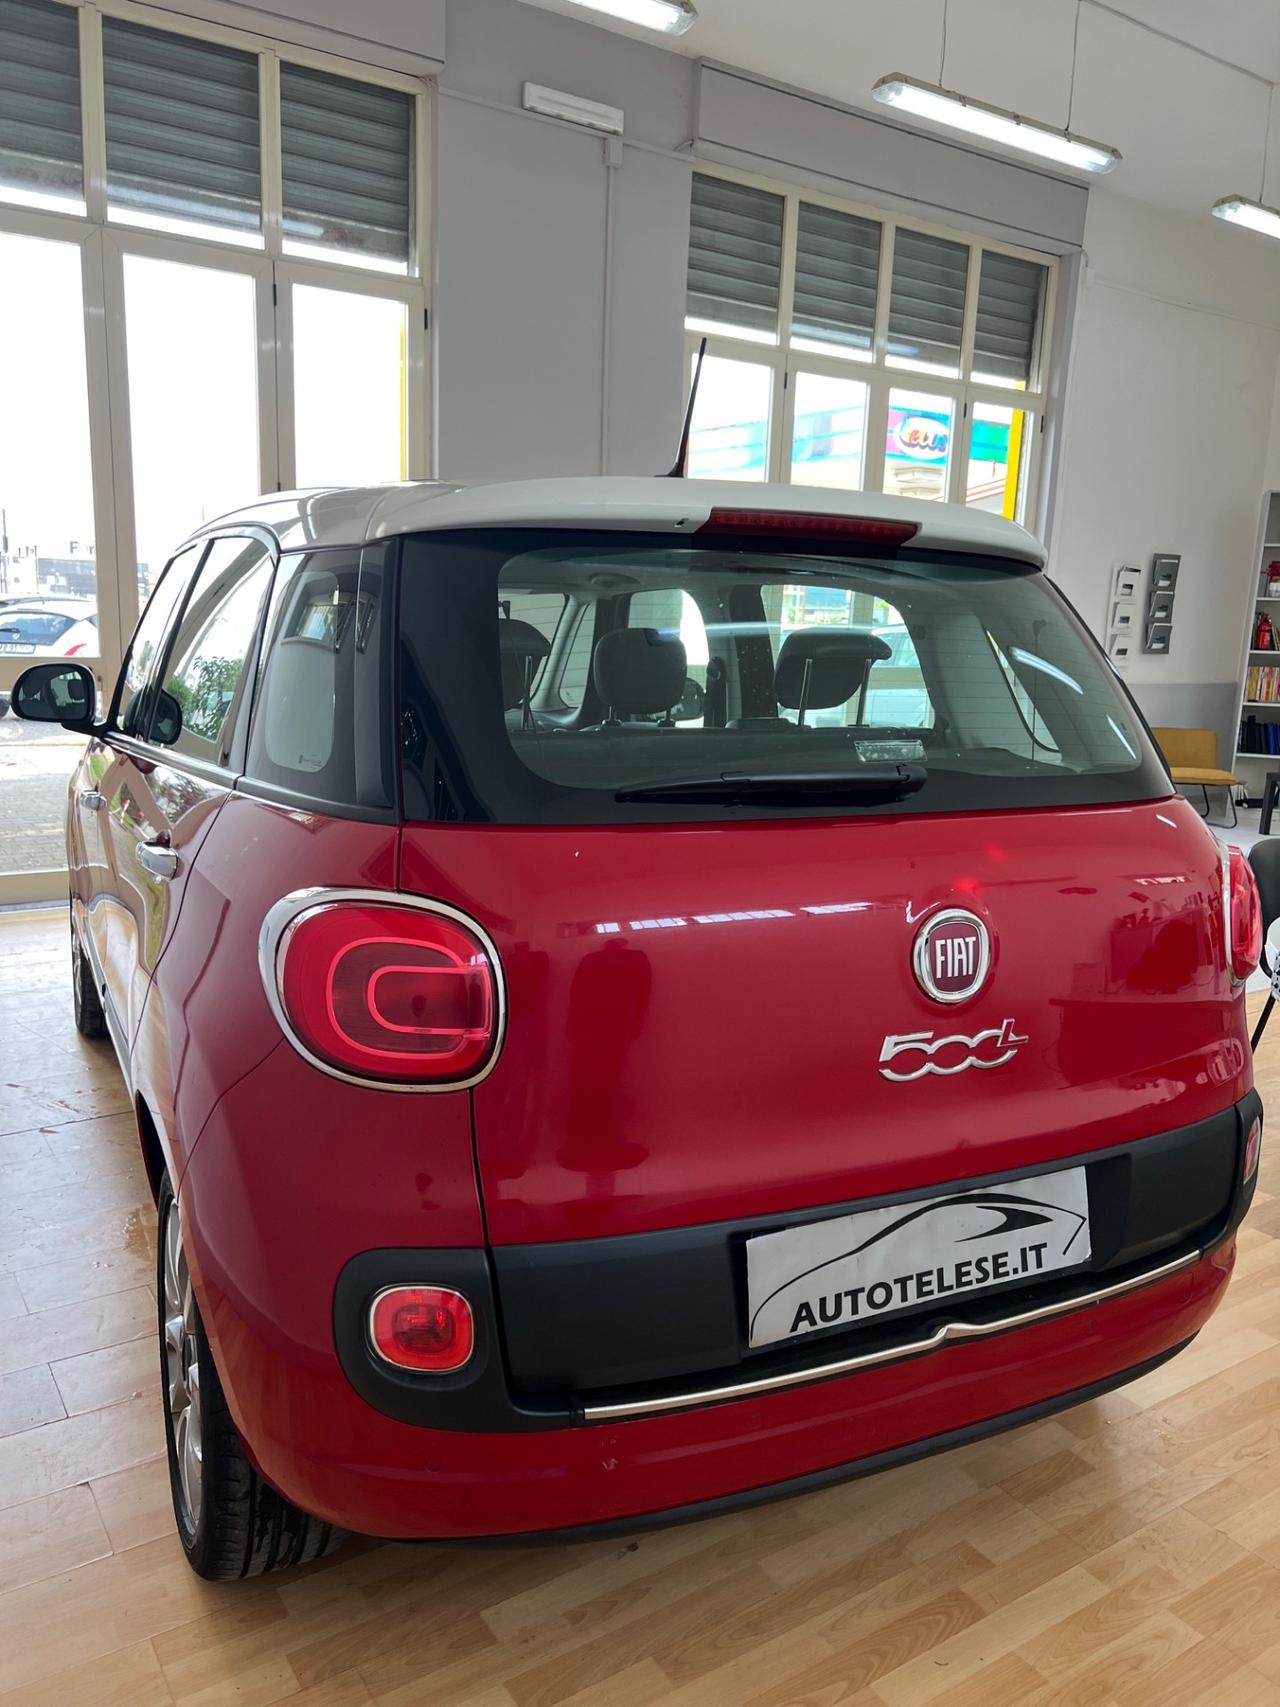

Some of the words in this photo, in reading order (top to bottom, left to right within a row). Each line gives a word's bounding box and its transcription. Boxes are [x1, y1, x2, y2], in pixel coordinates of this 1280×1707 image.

[935, 936, 977, 979] FIAT
[878, 1018, 1029, 1082] 500L
[789, 1242, 1048, 1334] AUTOTELESE.IT
